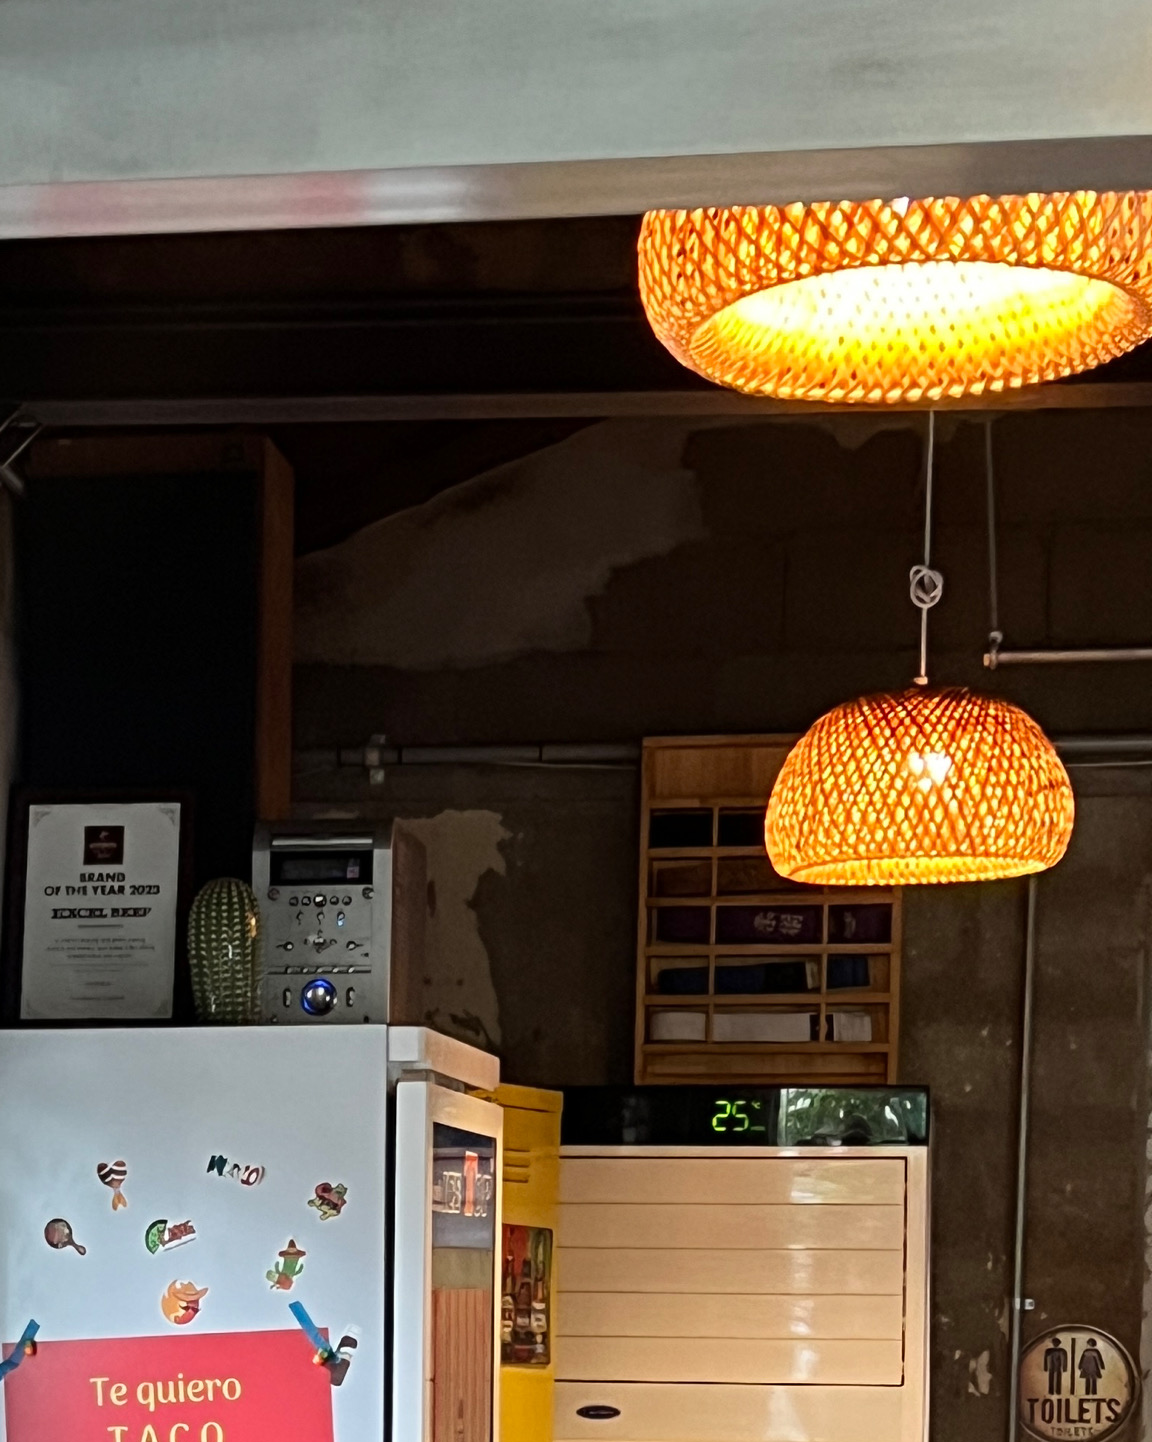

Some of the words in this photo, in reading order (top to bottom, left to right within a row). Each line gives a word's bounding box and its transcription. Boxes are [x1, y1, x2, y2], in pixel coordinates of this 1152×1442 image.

[79, 872, 126, 883] BRAND
[92, 885, 125, 896] YEAR
[89, 1377, 128, 1407] Te
[136, 1372, 242, 1412] quiero
[1027, 1398, 1121, 1424] TOILETS
